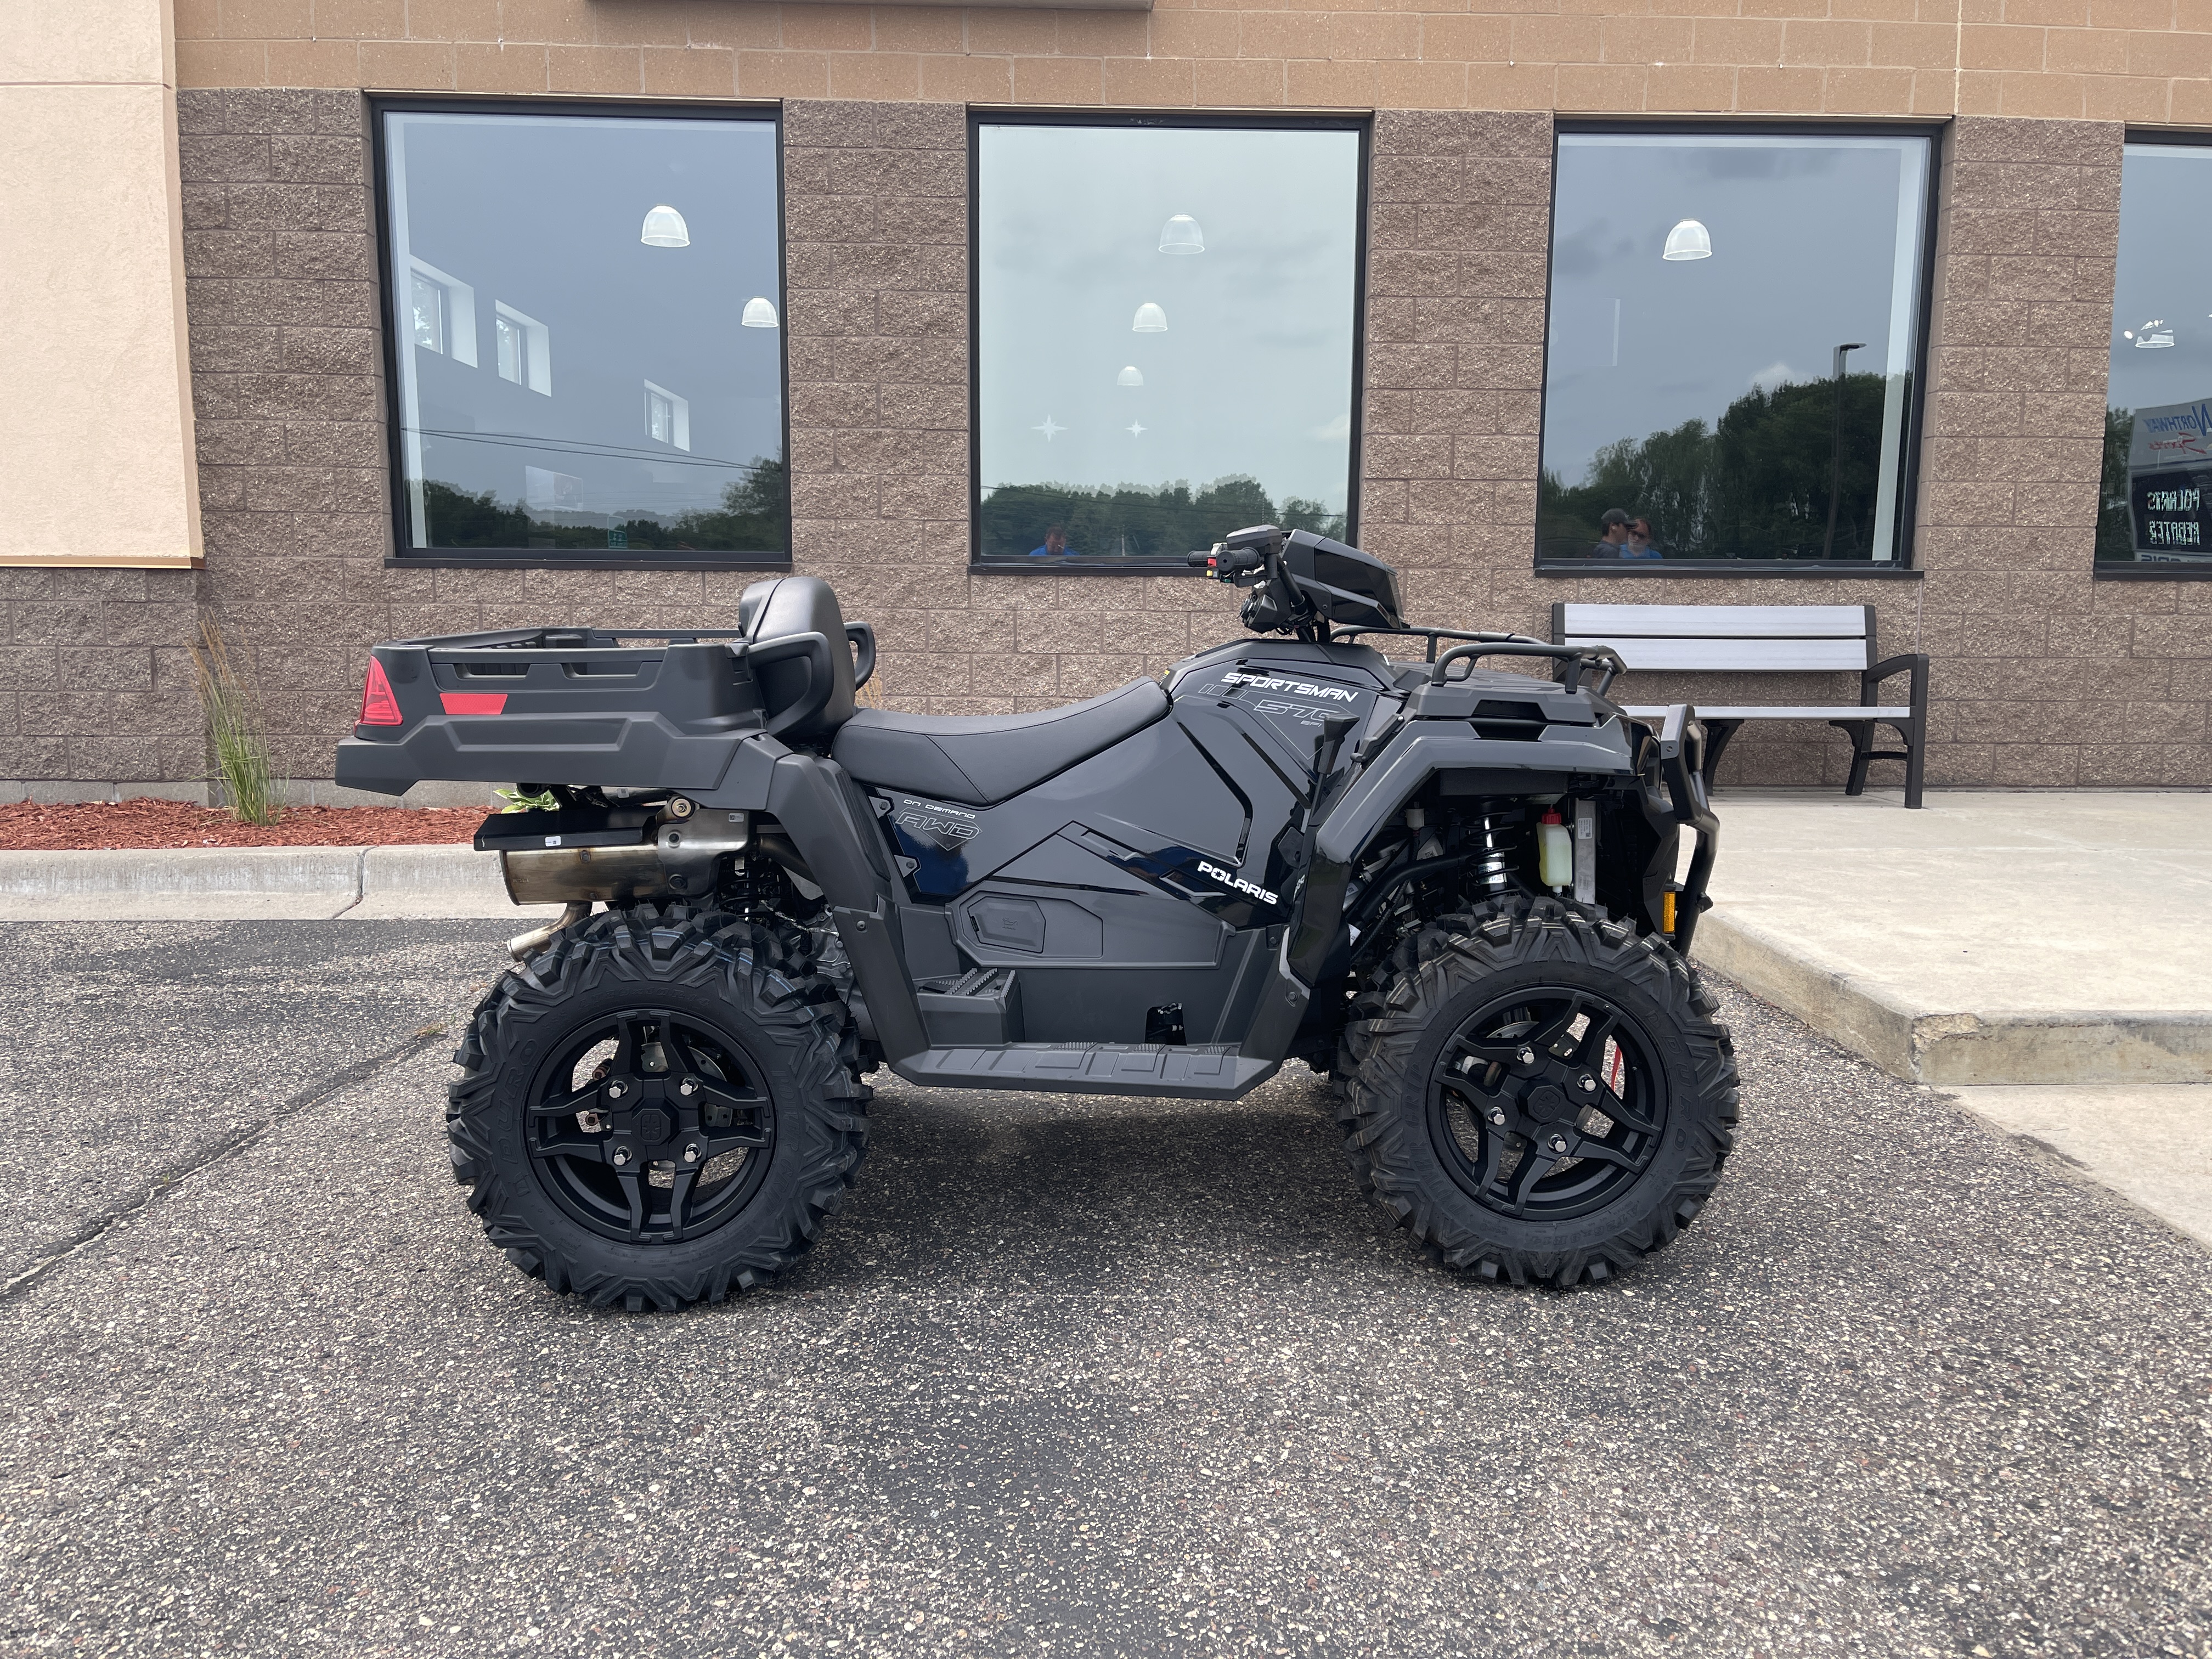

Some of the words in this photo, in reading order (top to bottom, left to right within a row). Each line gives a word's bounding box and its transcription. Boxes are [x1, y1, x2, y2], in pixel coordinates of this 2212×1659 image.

[1221, 672, 1358, 702] SPORTSMAN
[895, 811, 980, 839] AWD
[925, 804, 975, 819] DEMAND
[1198, 861, 1278, 905] POLARIS
[496, 1039, 538, 1164] DURO
[770, 1070, 800, 1152] POWER
[1404, 1063, 1423, 1128] GRIP
[1661, 1035, 1693, 1151] DURO
[763, 1158, 794, 1216] GRIP
